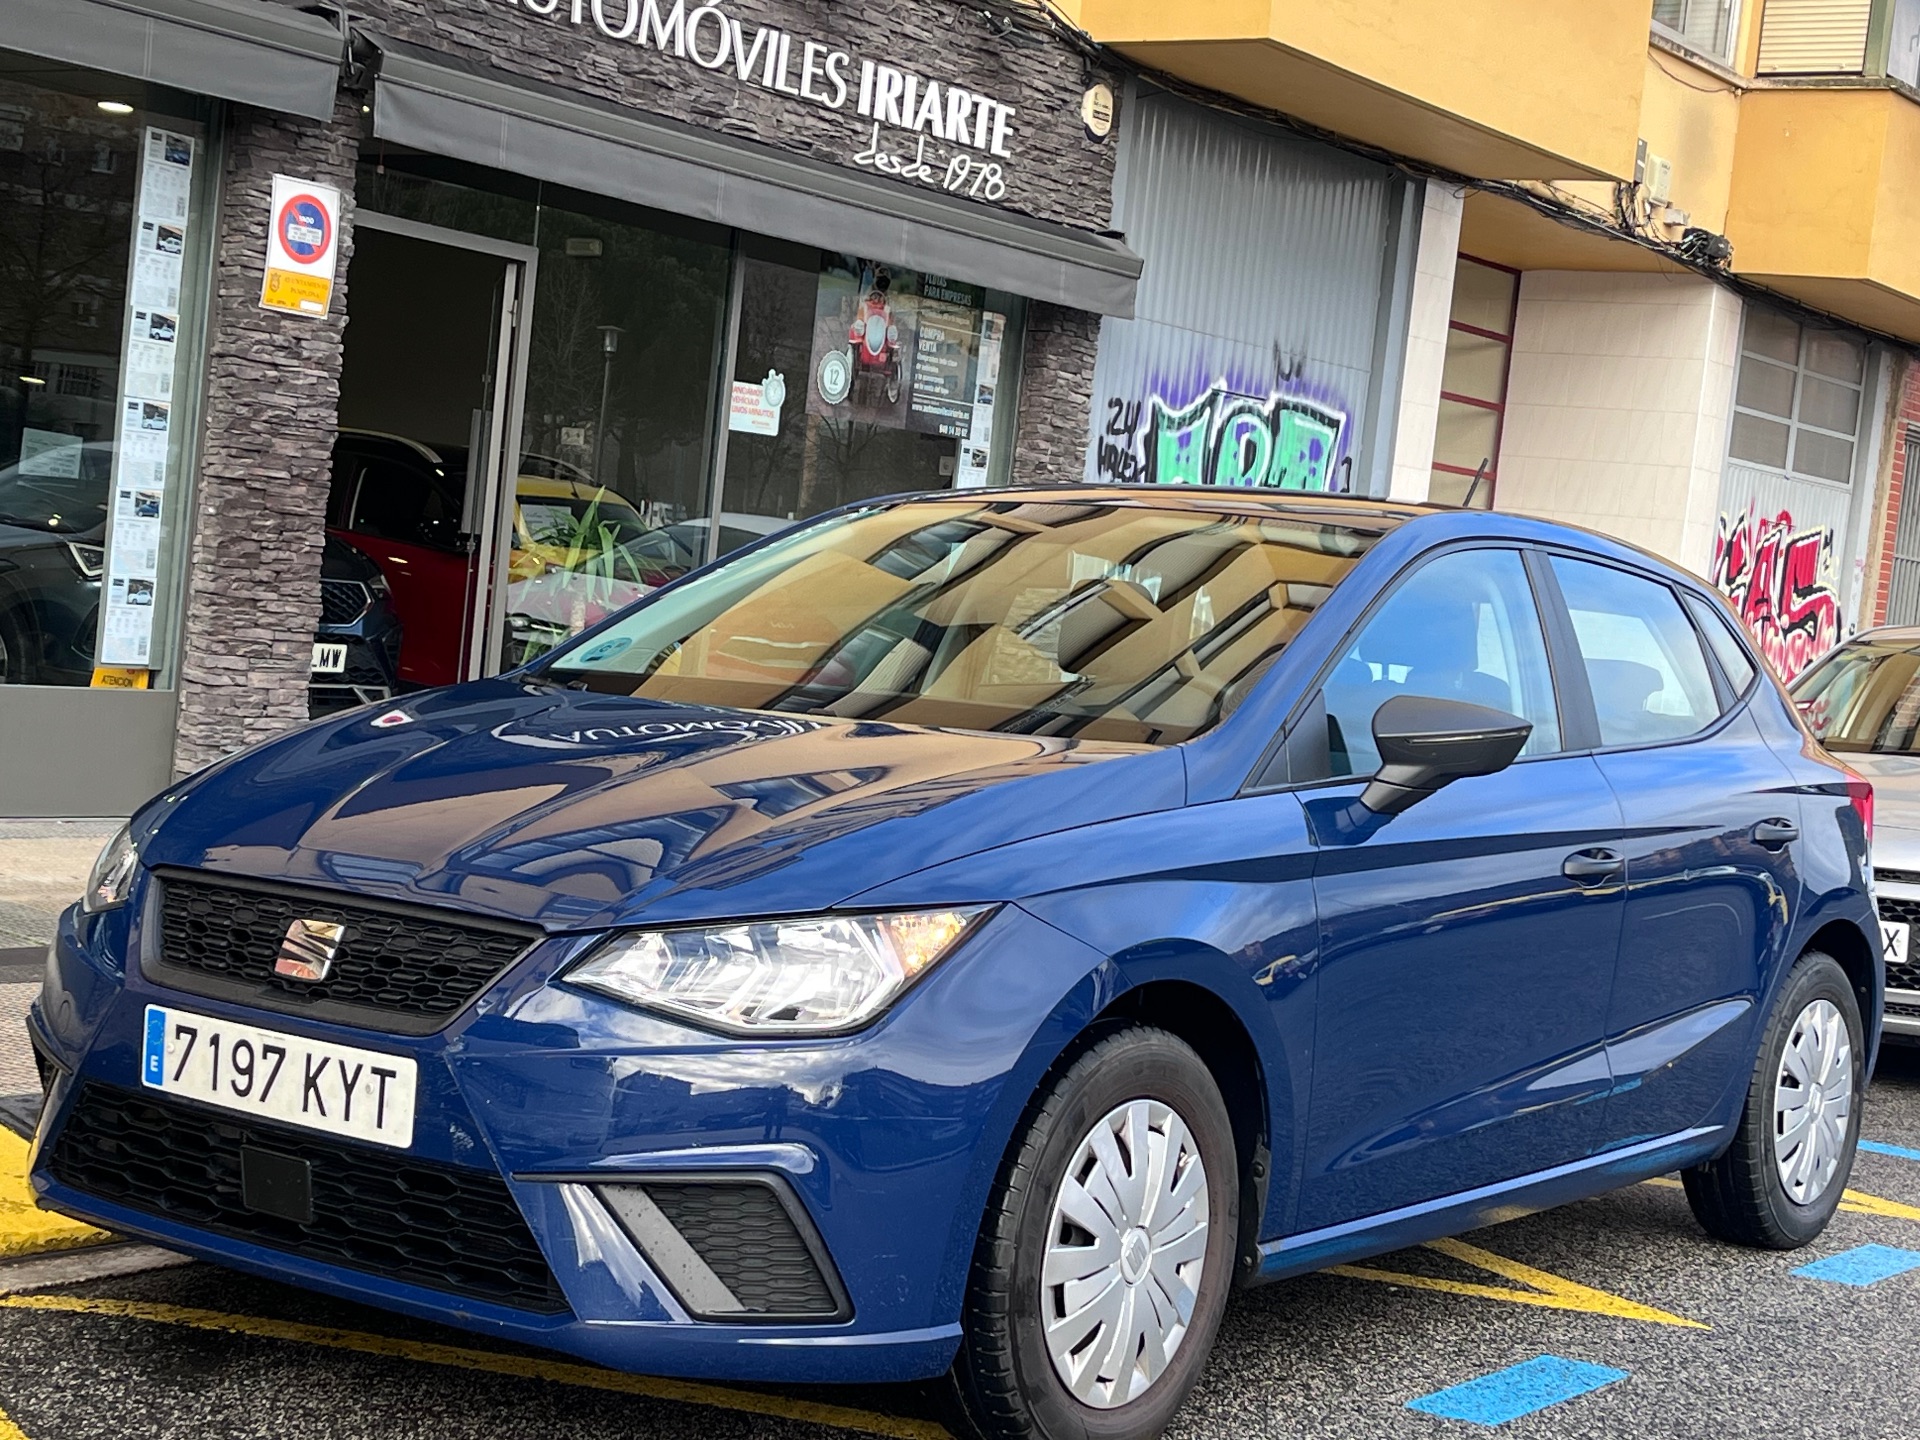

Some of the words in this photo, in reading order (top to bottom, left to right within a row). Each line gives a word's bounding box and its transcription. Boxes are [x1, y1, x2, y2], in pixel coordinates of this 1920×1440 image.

[507, 0, 849, 108] OMÓVILES
[857, 60, 1016, 158] IRIARTE
[853, 121, 935, 183] desde
[943, 154, 1005, 200] 1978
[830, 369, 839, 385] 12
[1883, 927, 1900, 957] X
[150, 1054, 160, 1073] E
[173, 1024, 286, 1103] 7197
[302, 1053, 397, 1130] KYT
